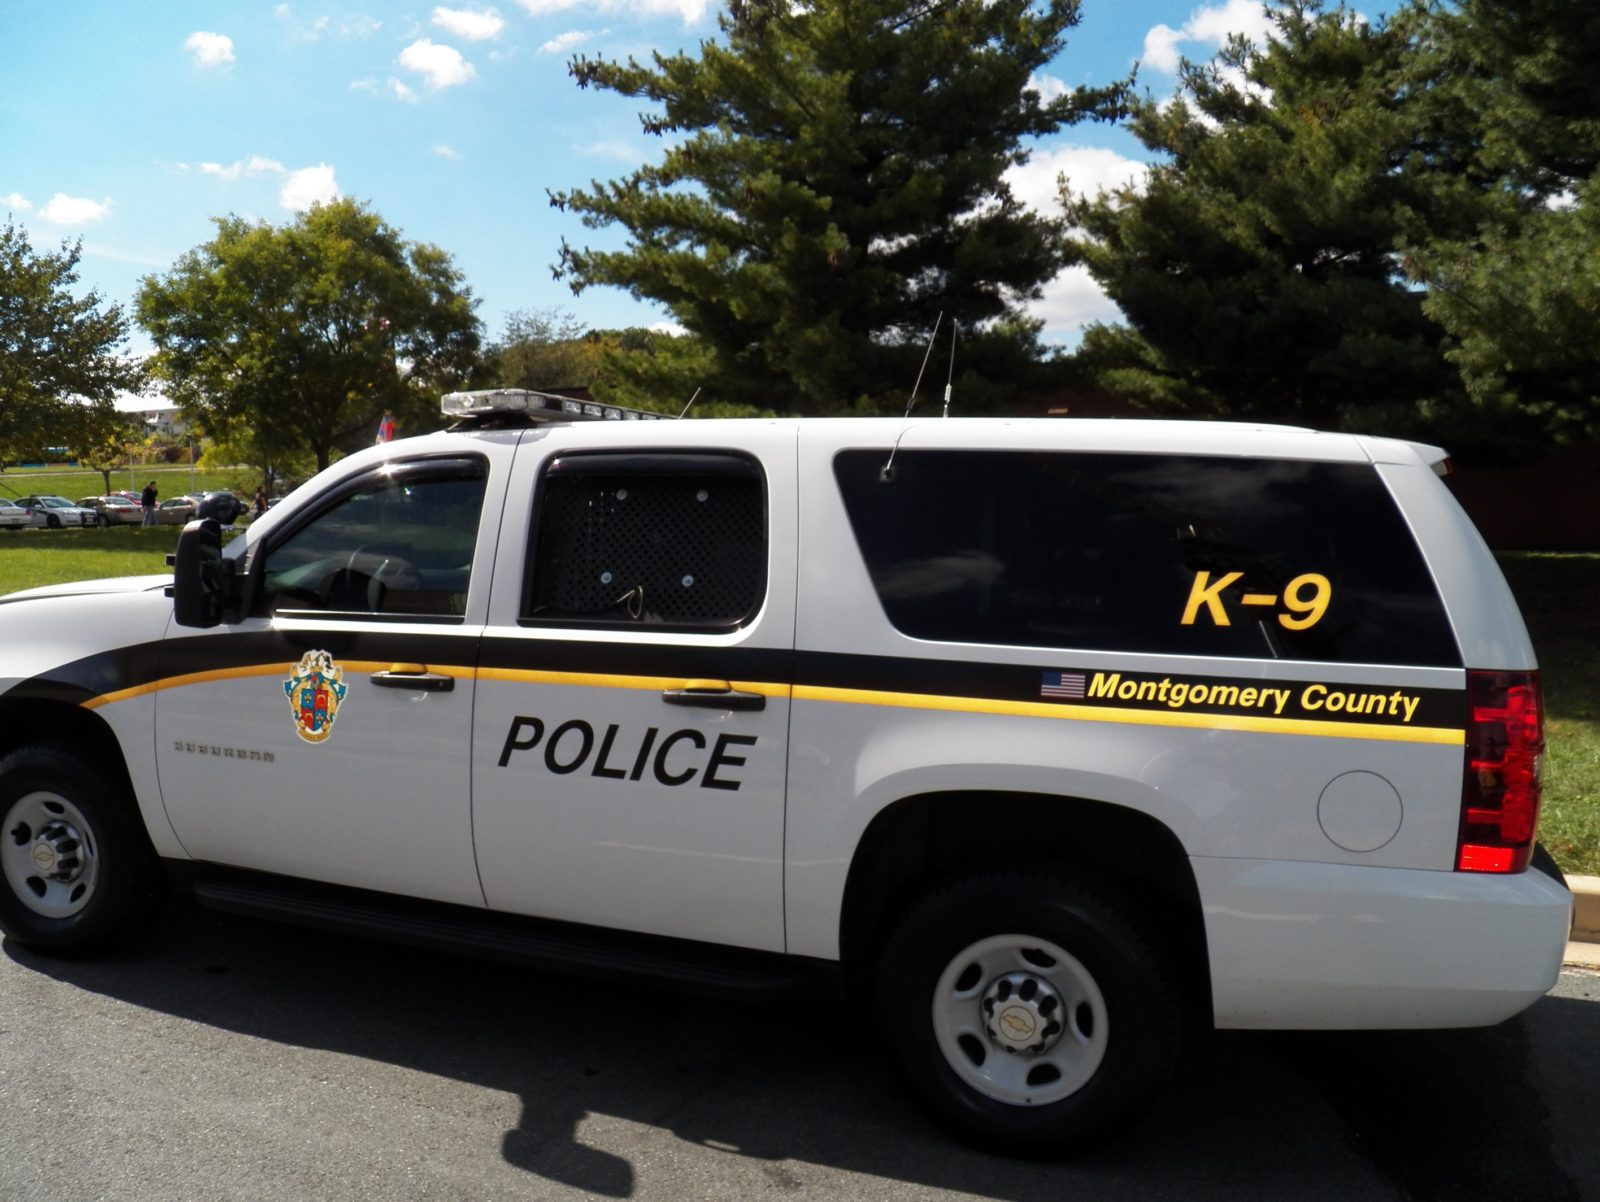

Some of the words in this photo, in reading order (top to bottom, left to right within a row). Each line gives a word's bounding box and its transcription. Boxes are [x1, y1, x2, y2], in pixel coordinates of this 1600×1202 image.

[1180, 571, 1332, 630] K-9
[1087, 673, 1291, 714] Montgomery
[1300, 684, 1420, 722] County
[498, 715, 758, 791] POLICE
